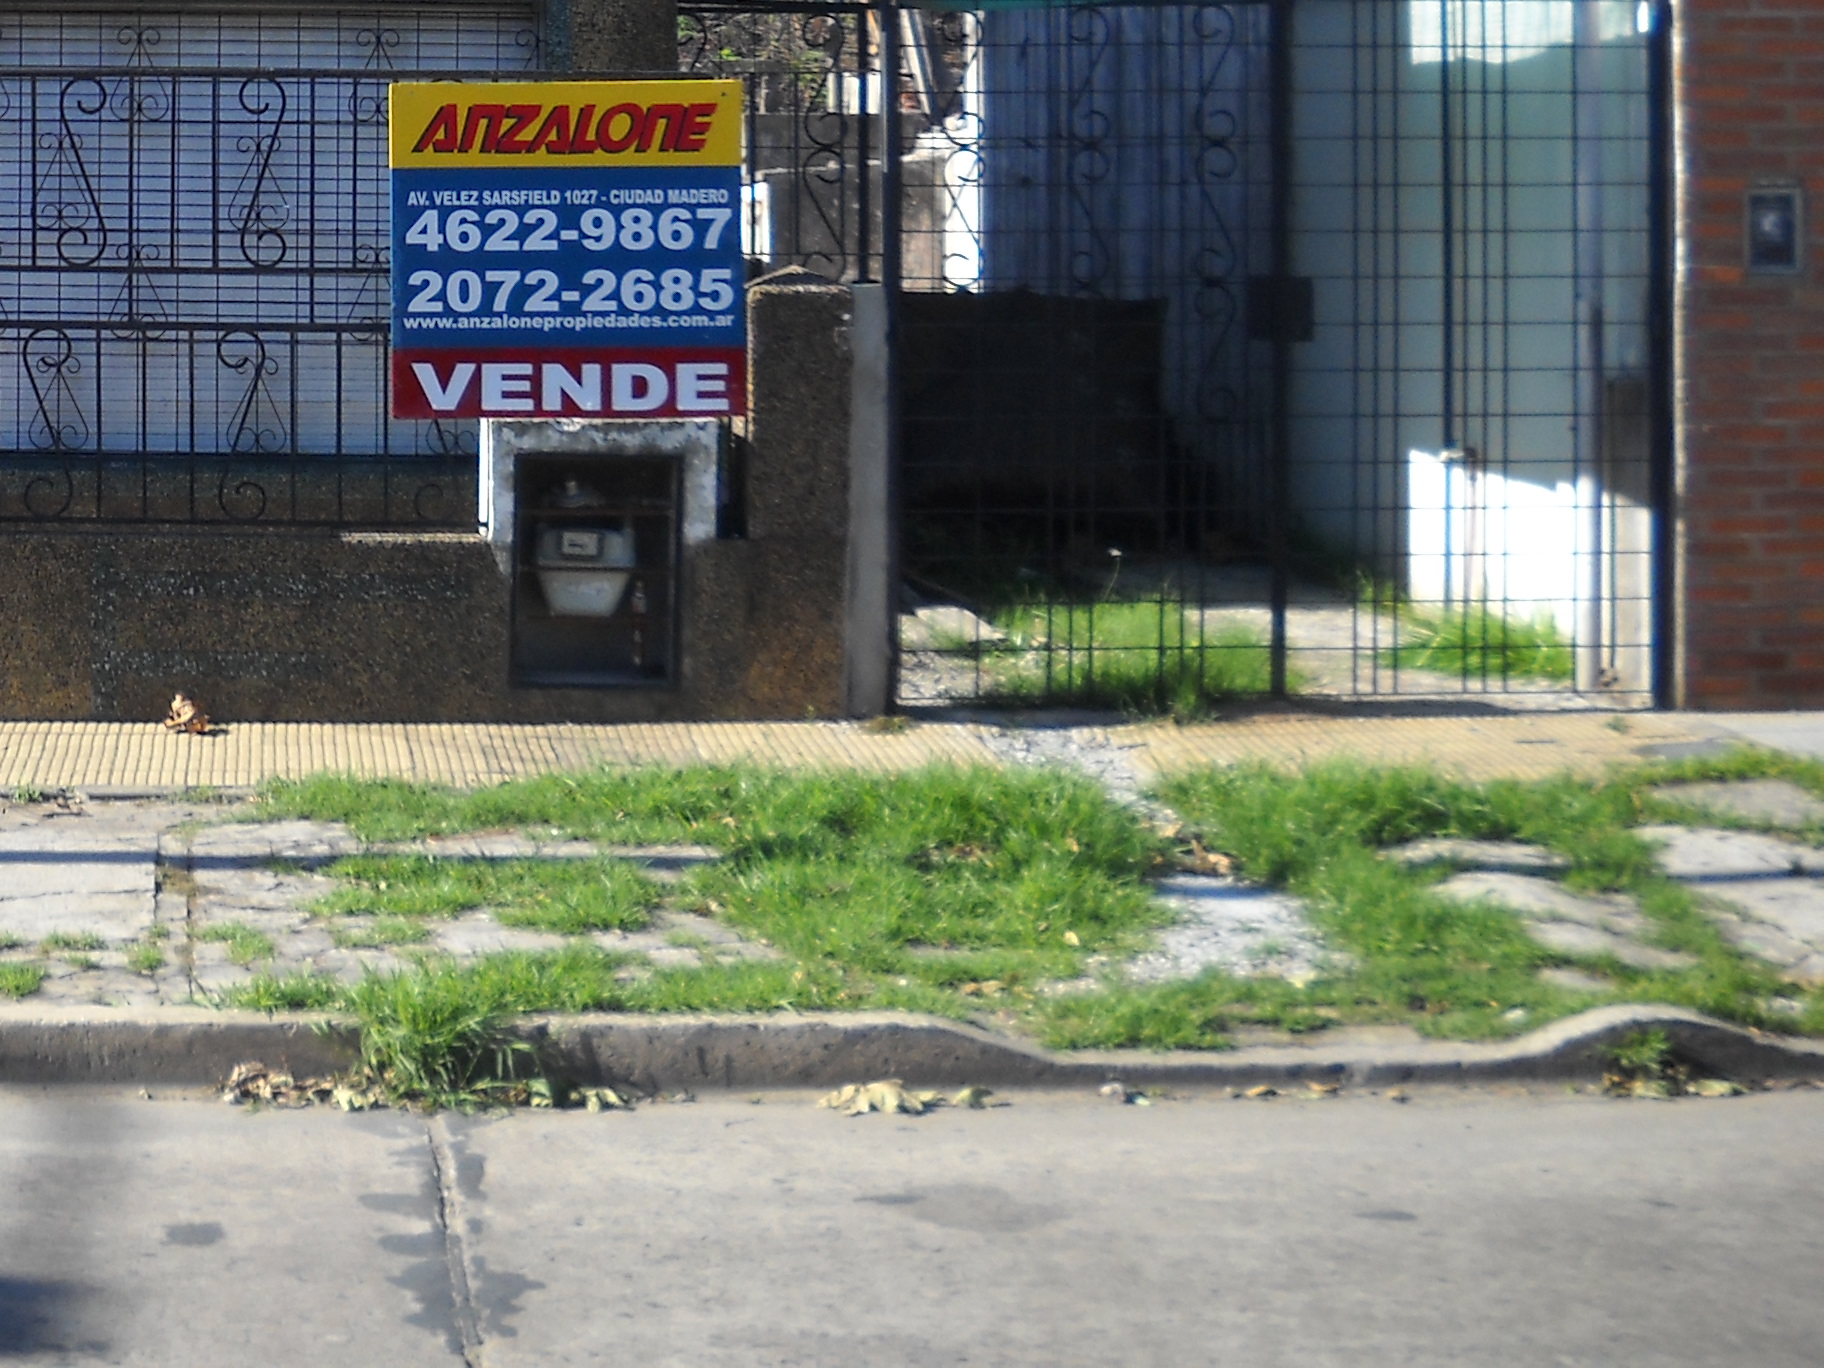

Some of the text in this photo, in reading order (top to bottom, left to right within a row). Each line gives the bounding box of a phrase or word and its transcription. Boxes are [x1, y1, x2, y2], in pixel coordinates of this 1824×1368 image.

[411, 102, 718, 154] ANZALONE
[407, 191, 429, 206] AV.
[433, 191, 479, 206] VELEZ
[482, 190, 560, 205] SARSFIELD
[565, 190, 598, 205] 1027
[609, 189, 664, 204] CIUDAD
[667, 189, 729, 204] MADERO
[405, 208, 732, 252] 4622-9867
[407, 268, 734, 313] 2072-2685
[403, 314, 734, 331] www.anzalonepropiedades.com.ar
[411, 362, 730, 412] VENDE
